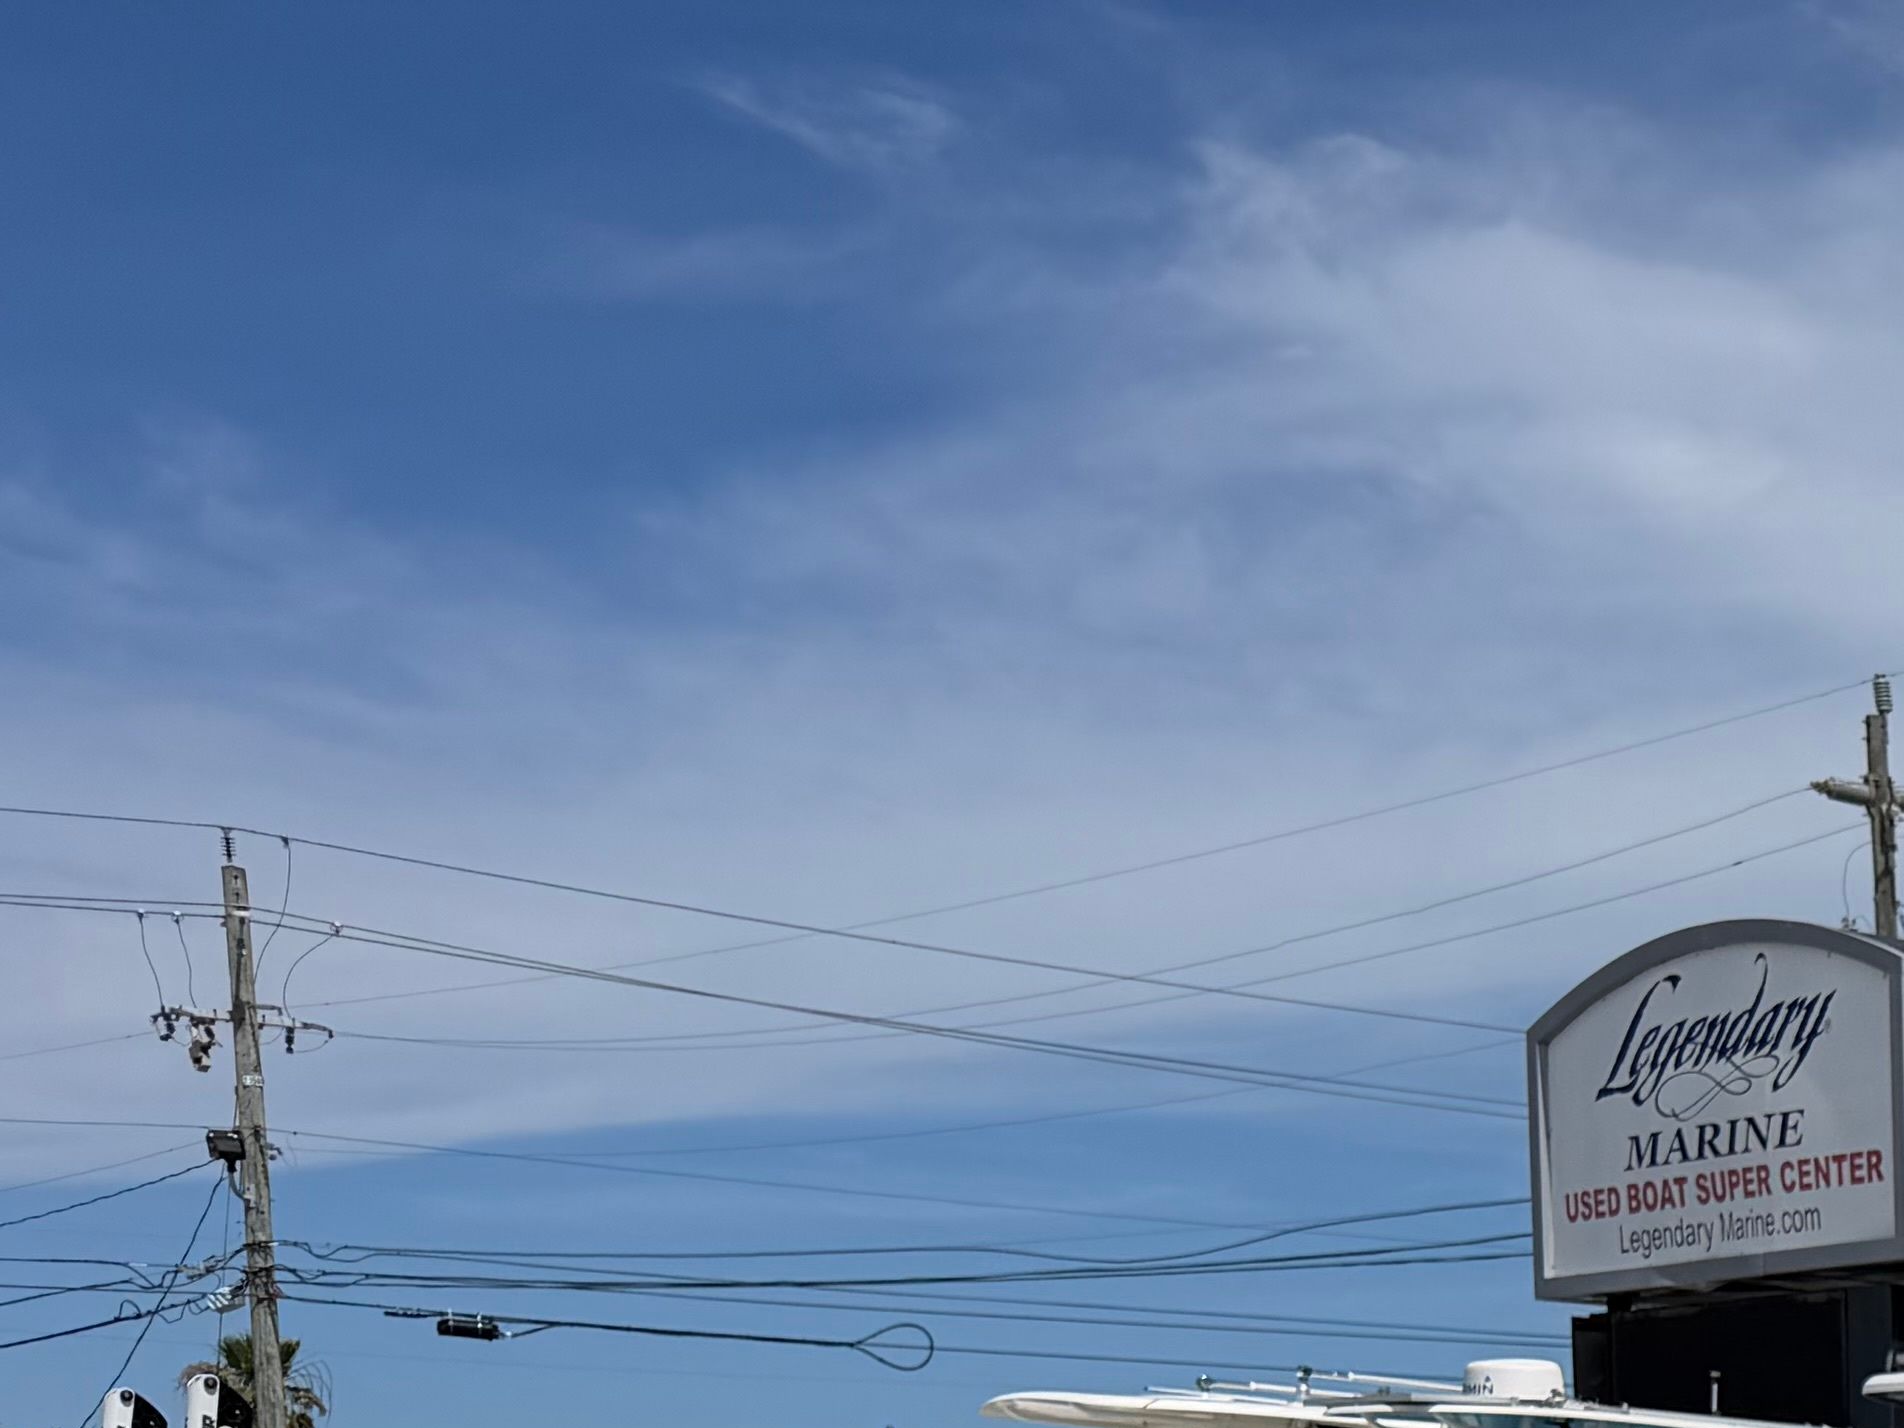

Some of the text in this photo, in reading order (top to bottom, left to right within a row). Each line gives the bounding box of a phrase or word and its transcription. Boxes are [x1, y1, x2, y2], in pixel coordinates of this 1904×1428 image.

[1595, 952, 1837, 1108] Legendary
[1623, 1109, 1805, 1172] MARINE
[1565, 1150, 1885, 1223] USED BOAT SUPER CENTER
[1619, 1206, 1822, 1260] Legendary Marine.com
